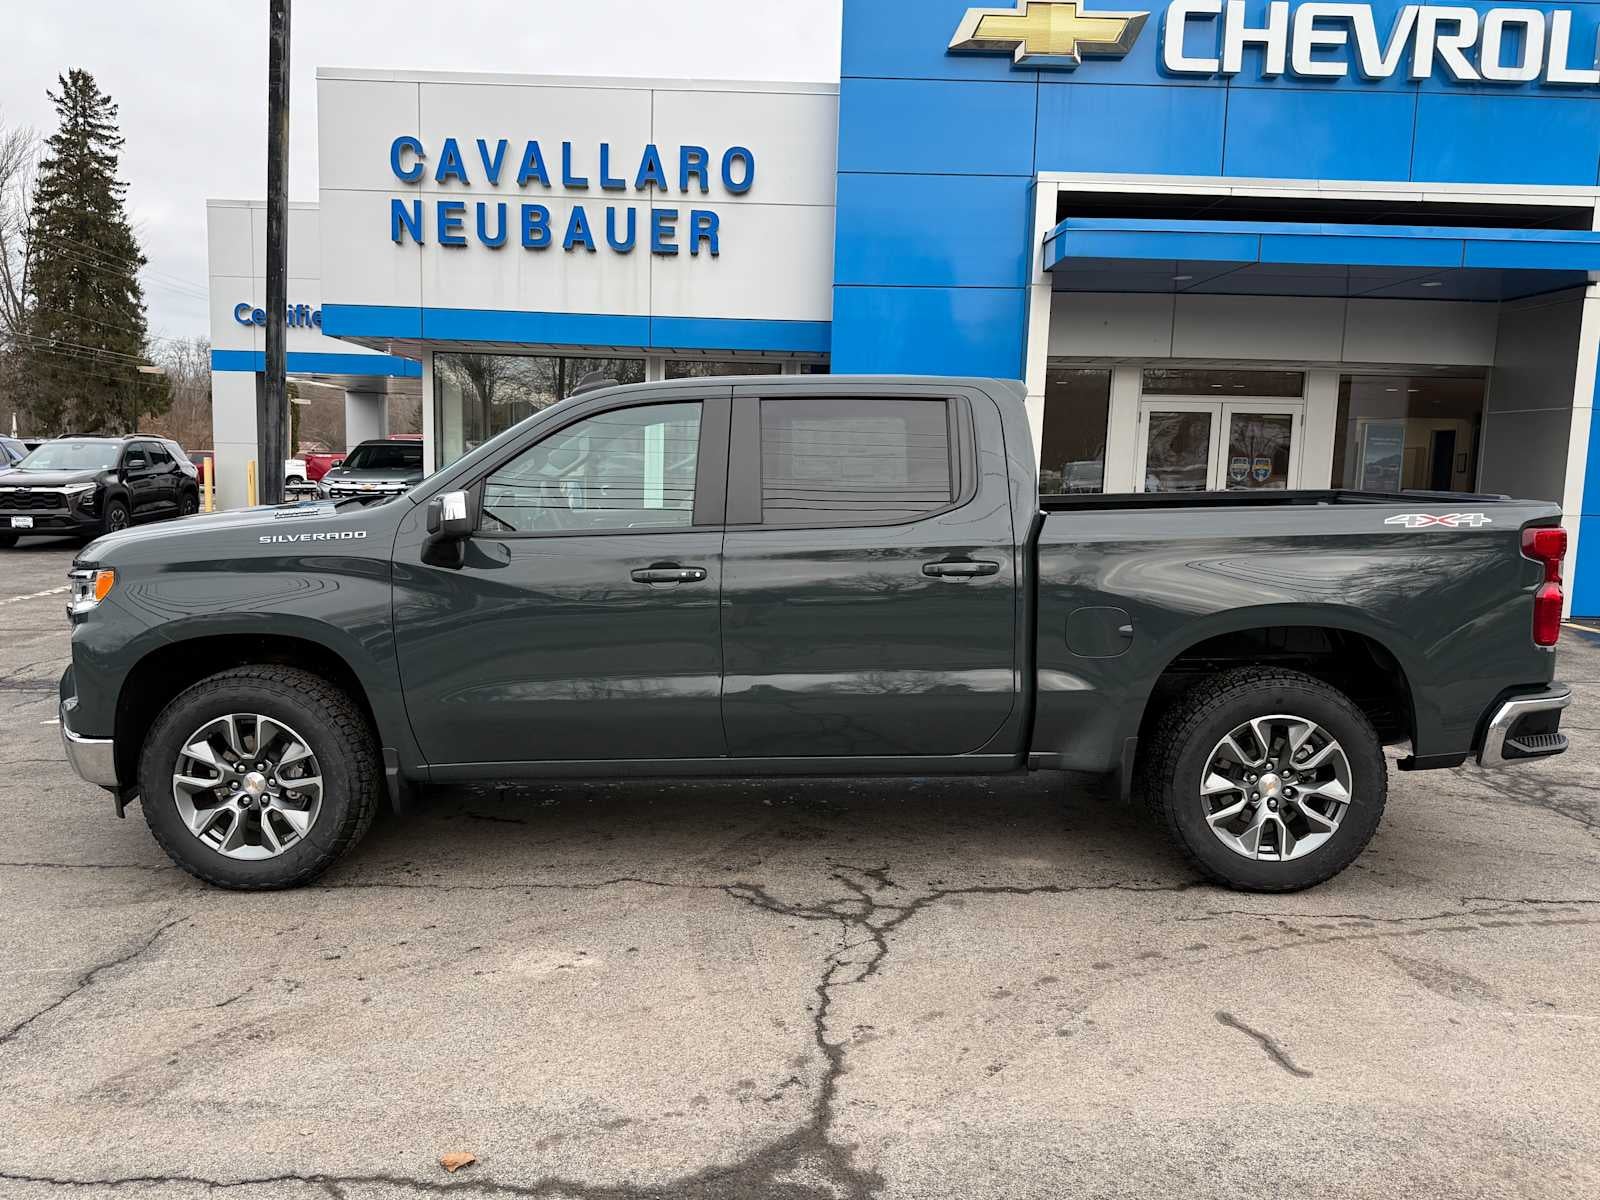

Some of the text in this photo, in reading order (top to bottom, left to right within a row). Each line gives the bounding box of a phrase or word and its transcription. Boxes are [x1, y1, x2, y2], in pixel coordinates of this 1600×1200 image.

[1164, 0, 1600, 84] CHEVROL
[390, 136, 755, 195] CAVALLARO
[391, 198, 720, 257] NEUBAUER
[234, 303, 322, 328] Ceifie
[259, 530, 368, 544] SILVERADO
